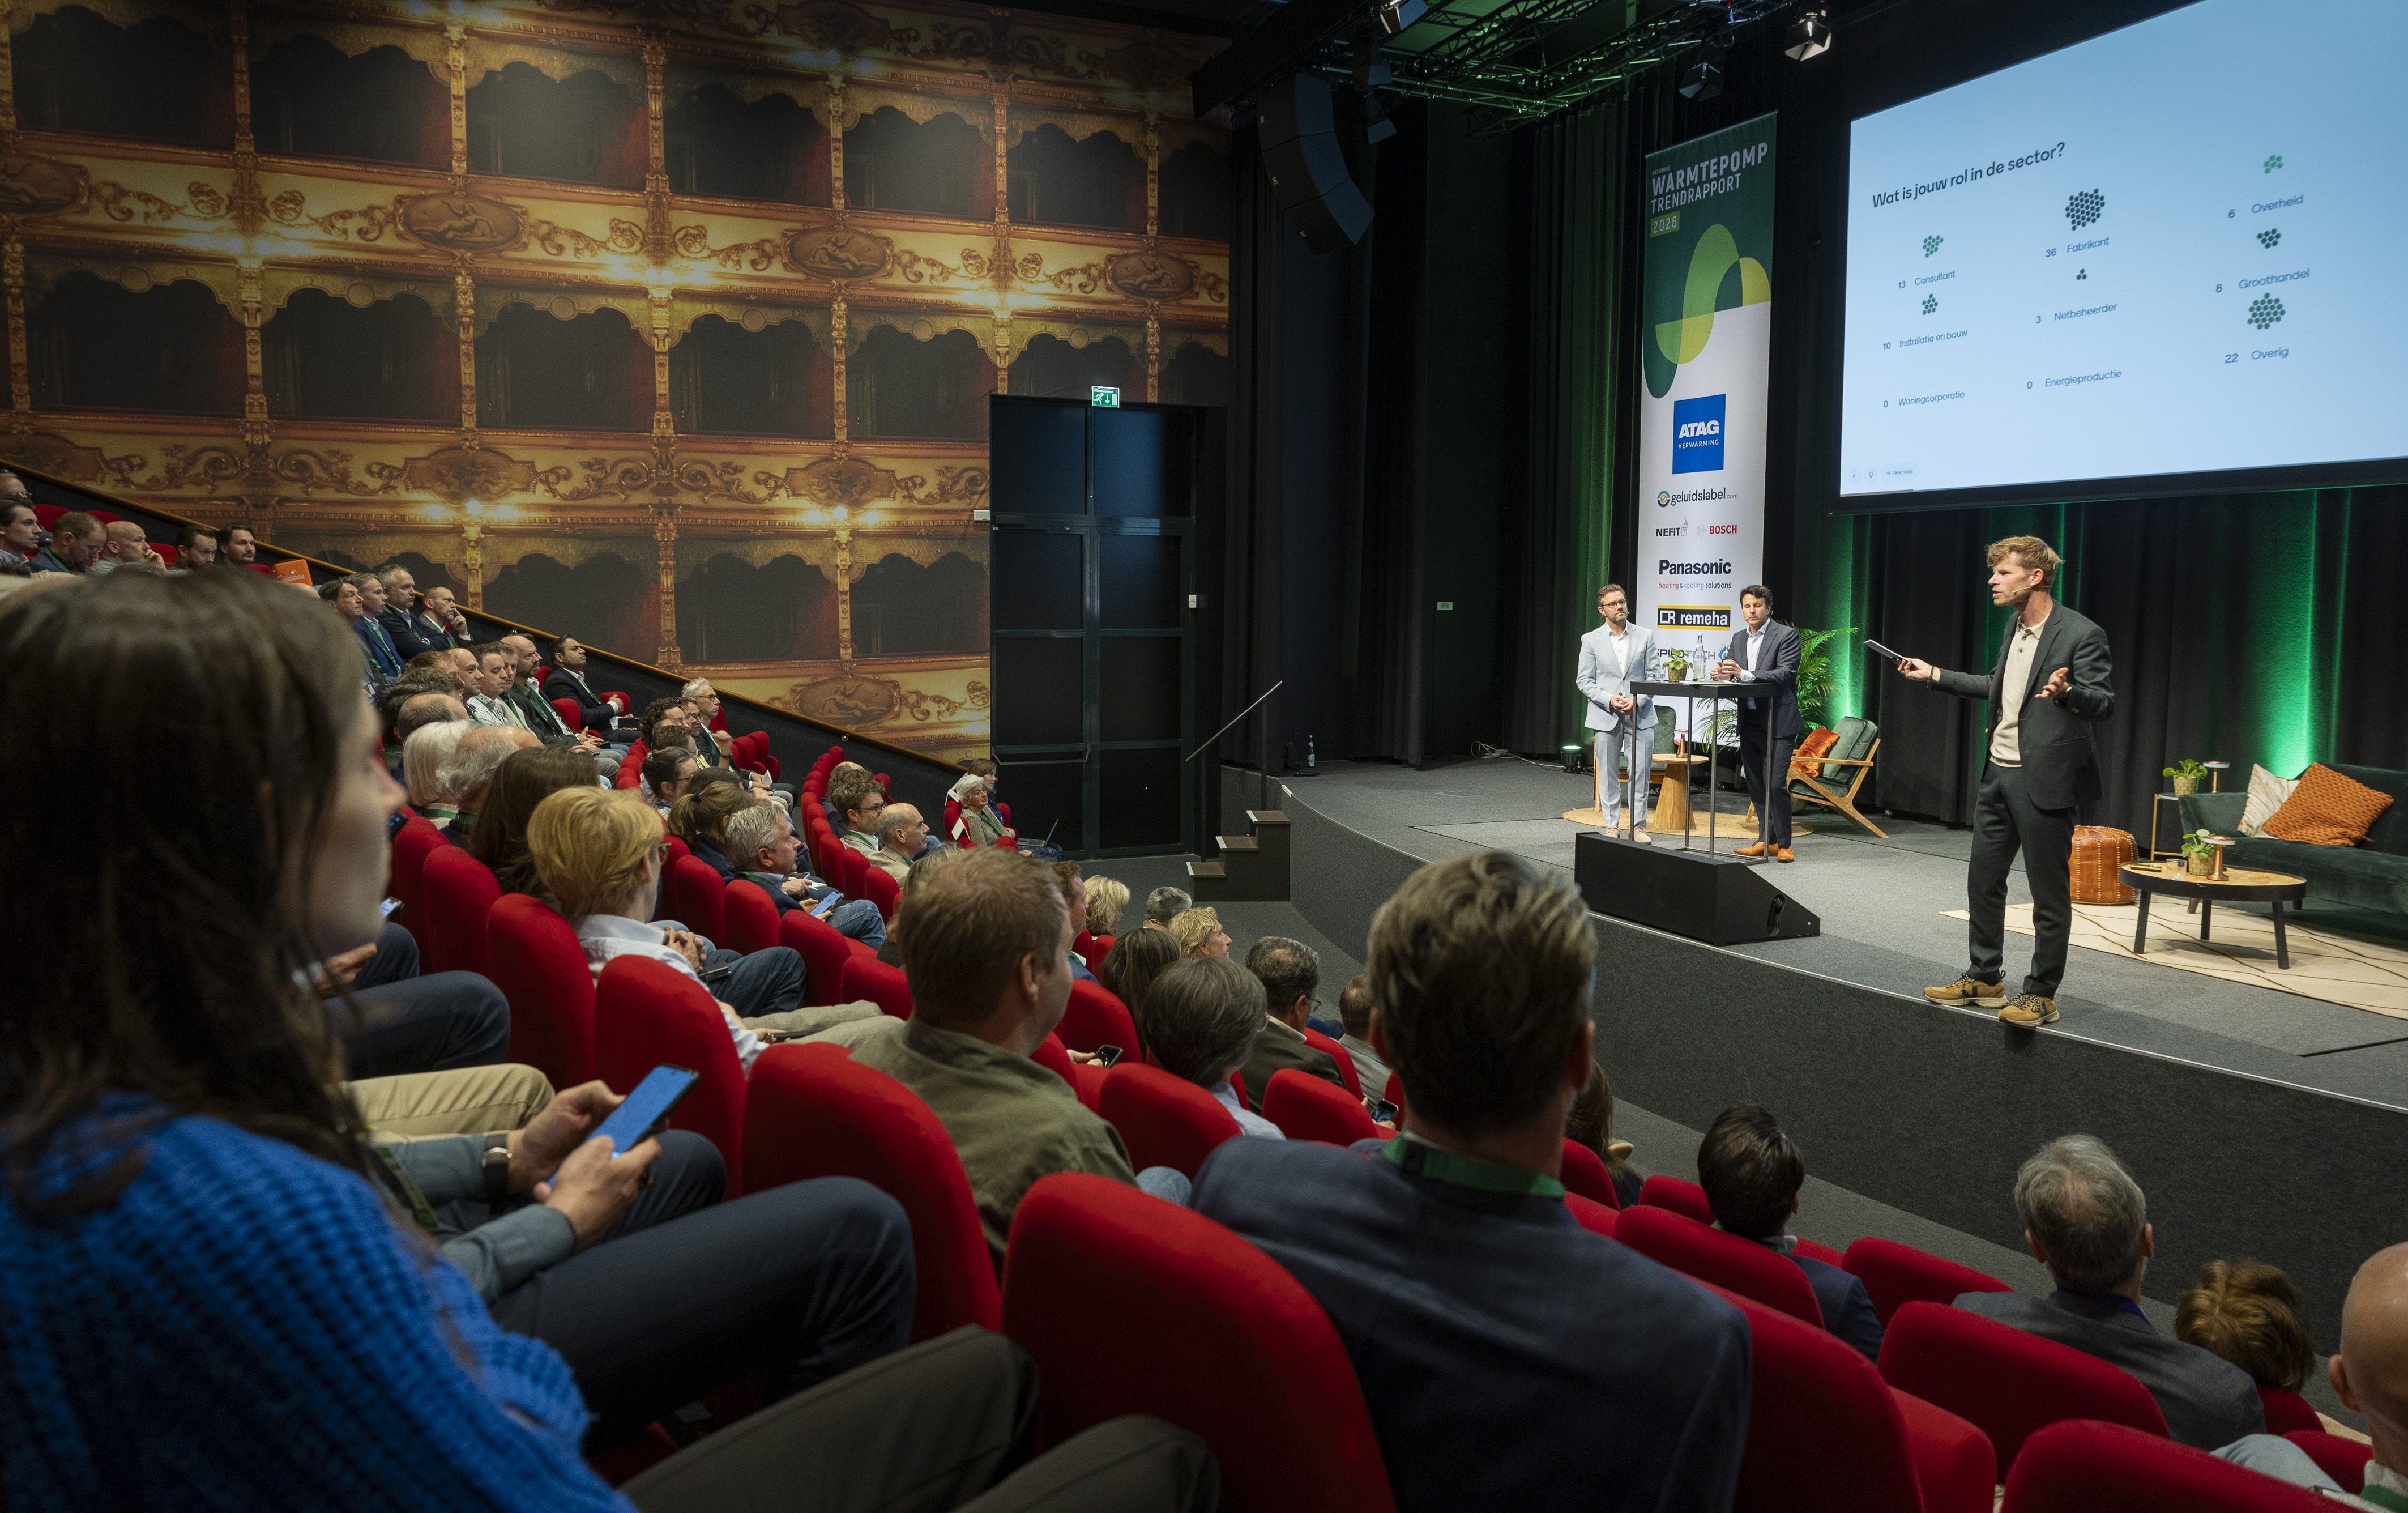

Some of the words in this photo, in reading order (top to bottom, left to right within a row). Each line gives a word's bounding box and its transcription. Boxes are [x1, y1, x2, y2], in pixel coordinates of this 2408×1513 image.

[1652, 142, 1767, 196] WARMTEPOMP
[1873, 192, 1899, 208] Wat
[1902, 187, 1912, 200] is
[1914, 178, 1948, 200] jouw
[1950, 169, 1968, 187] rol
[1971, 168, 1983, 182] in
[1987, 161, 2004, 177] de
[2008, 142, 2065, 171] sector?
[1651, 173, 1741, 214] TRENDRAPPORT
[2228, 209, 2236, 219] 6
[2251, 194, 2304, 214] Overheid
[1653, 215, 1677, 233] 2026
[2045, 248, 2057, 257] 36
[2067, 236, 2110, 253] Fabrikant
[1898, 280, 1906, 289] 13
[1914, 270, 1956, 285] Consultant
[2215, 284, 2223, 293] 8
[2239, 268, 2310, 289] Groothandel
[2035, 316, 2042, 324] 3
[2054, 304, 2118, 321] Netbeheerder
[1882, 342, 1892, 350] 10
[1899, 335, 1934, 347] Installatie
[1946, 330, 1968, 339] bouw
[2225, 353, 2239, 363] 22
[2251, 347, 2289, 360] Overig
[2045, 370, 2122, 387] Energieproductie
[1898, 390, 1965, 406] Woningcorporatie
[1678, 420, 1719, 438] ATAG
[1678, 438, 1719, 449] VERWARMING
[1671, 487, 1738, 506] geluidslabel.com
[1656, 527, 1680, 536] NEFIT
[1709, 525, 1737, 534] BOSCH
[1659, 558, 1732, 575] Panasonic
[1658, 582, 1679, 590] heating
[1684, 582, 1704, 590] cooling
[1680, 611, 1728, 626] remeha
